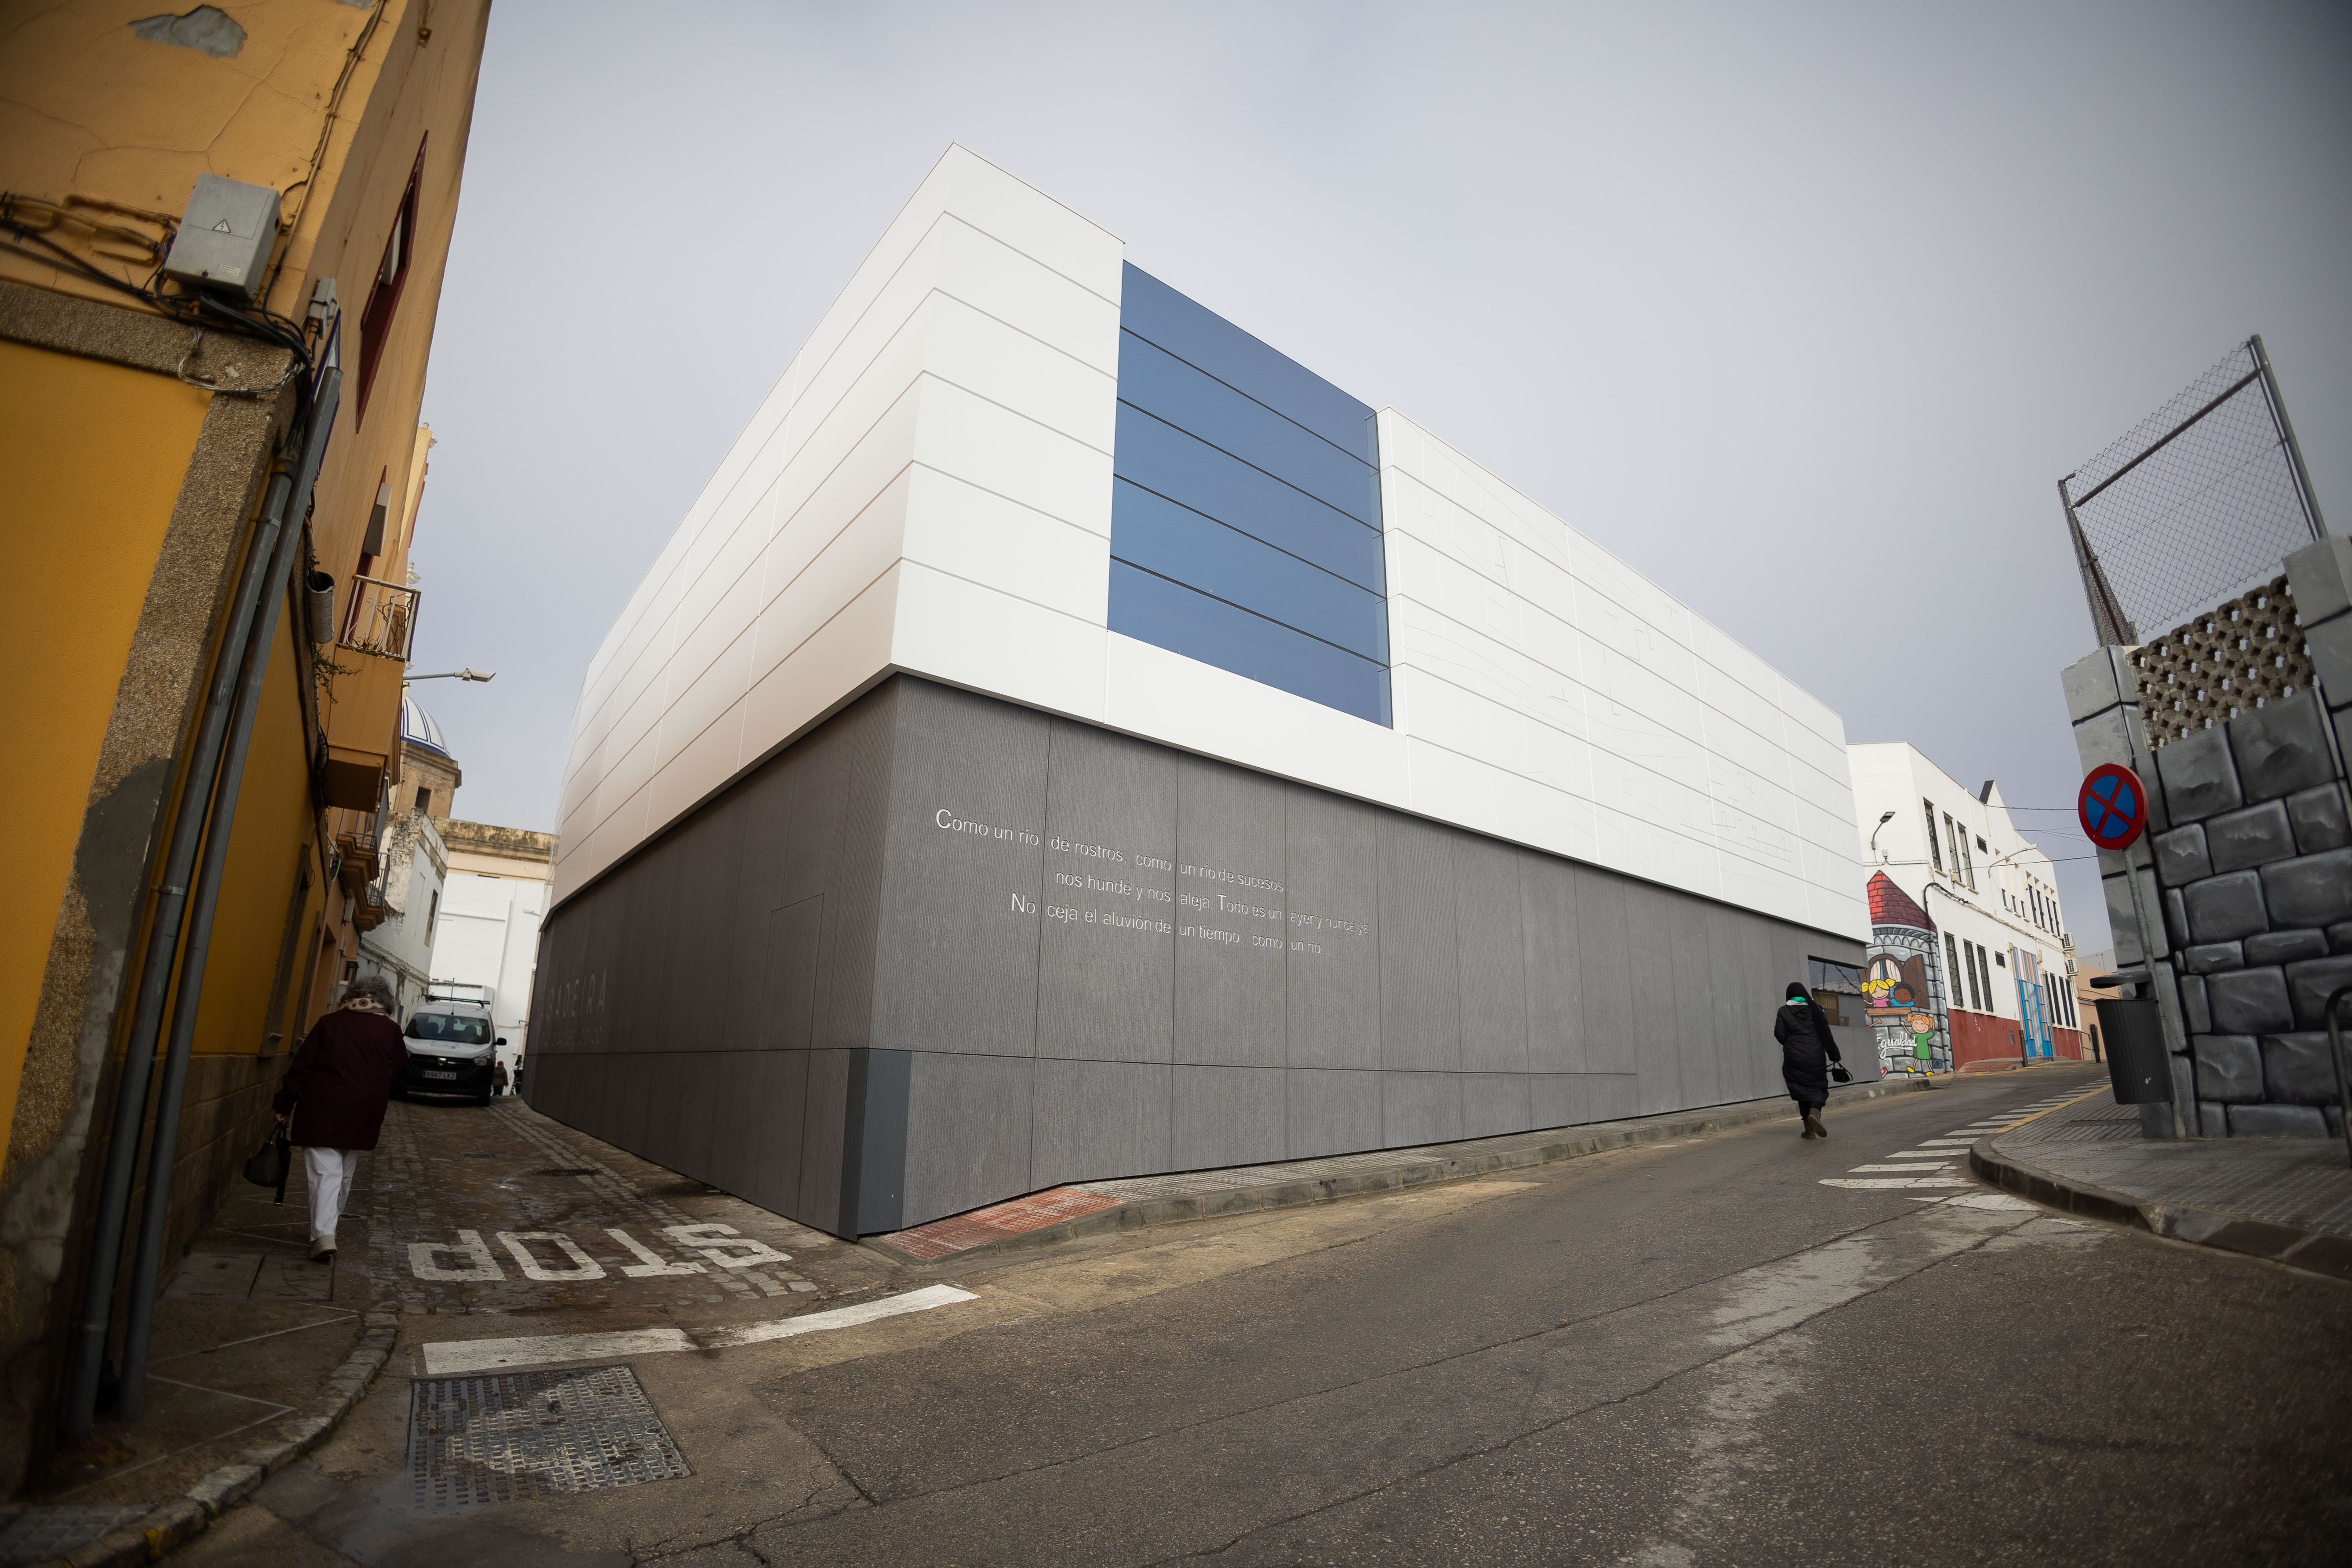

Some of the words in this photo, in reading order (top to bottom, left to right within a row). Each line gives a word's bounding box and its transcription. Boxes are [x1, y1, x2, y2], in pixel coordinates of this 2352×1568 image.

[936, 809, 988, 835] Como
[995, 826, 1013, 841] un
[1019, 828, 1039, 846] río
[1051, 835, 1069, 851] de
[1075, 842, 1127, 864] rostros,
[1136, 854, 1171, 871] como
[1181, 863, 1195, 875] un
[1200, 864, 1216, 879] río
[1218, 868, 1234, 882] de
[1238, 874, 1283, 892] sucesos
[1011, 892, 1036, 914] No
[1047, 903, 1077, 923] ceja
[1085, 908, 1097, 923] el
[1103, 910, 1152, 930] aluvión
[1155, 918, 1171, 934] de
[1180, 924, 1194, 937] un
[1253, 935, 1282, 949] como
[1291, 940, 1304, 952] un
[1308, 940, 1324, 954] río.
[1056, 872, 1083, 887] nos
[1088, 873, 1131, 895] hunde
[1136, 886, 1144, 901] y
[1148, 888, 1171, 902] nos
[1180, 891, 1213, 911] aleja.
[1217, 893, 1248, 914] Todo
[1253, 906, 1265, 917] es
[1269, 908, 1282, 920] un
[1291, 912, 1314, 926] ayer
[1317, 916, 1323, 929] y
[407, 1223, 793, 1281] STOP
